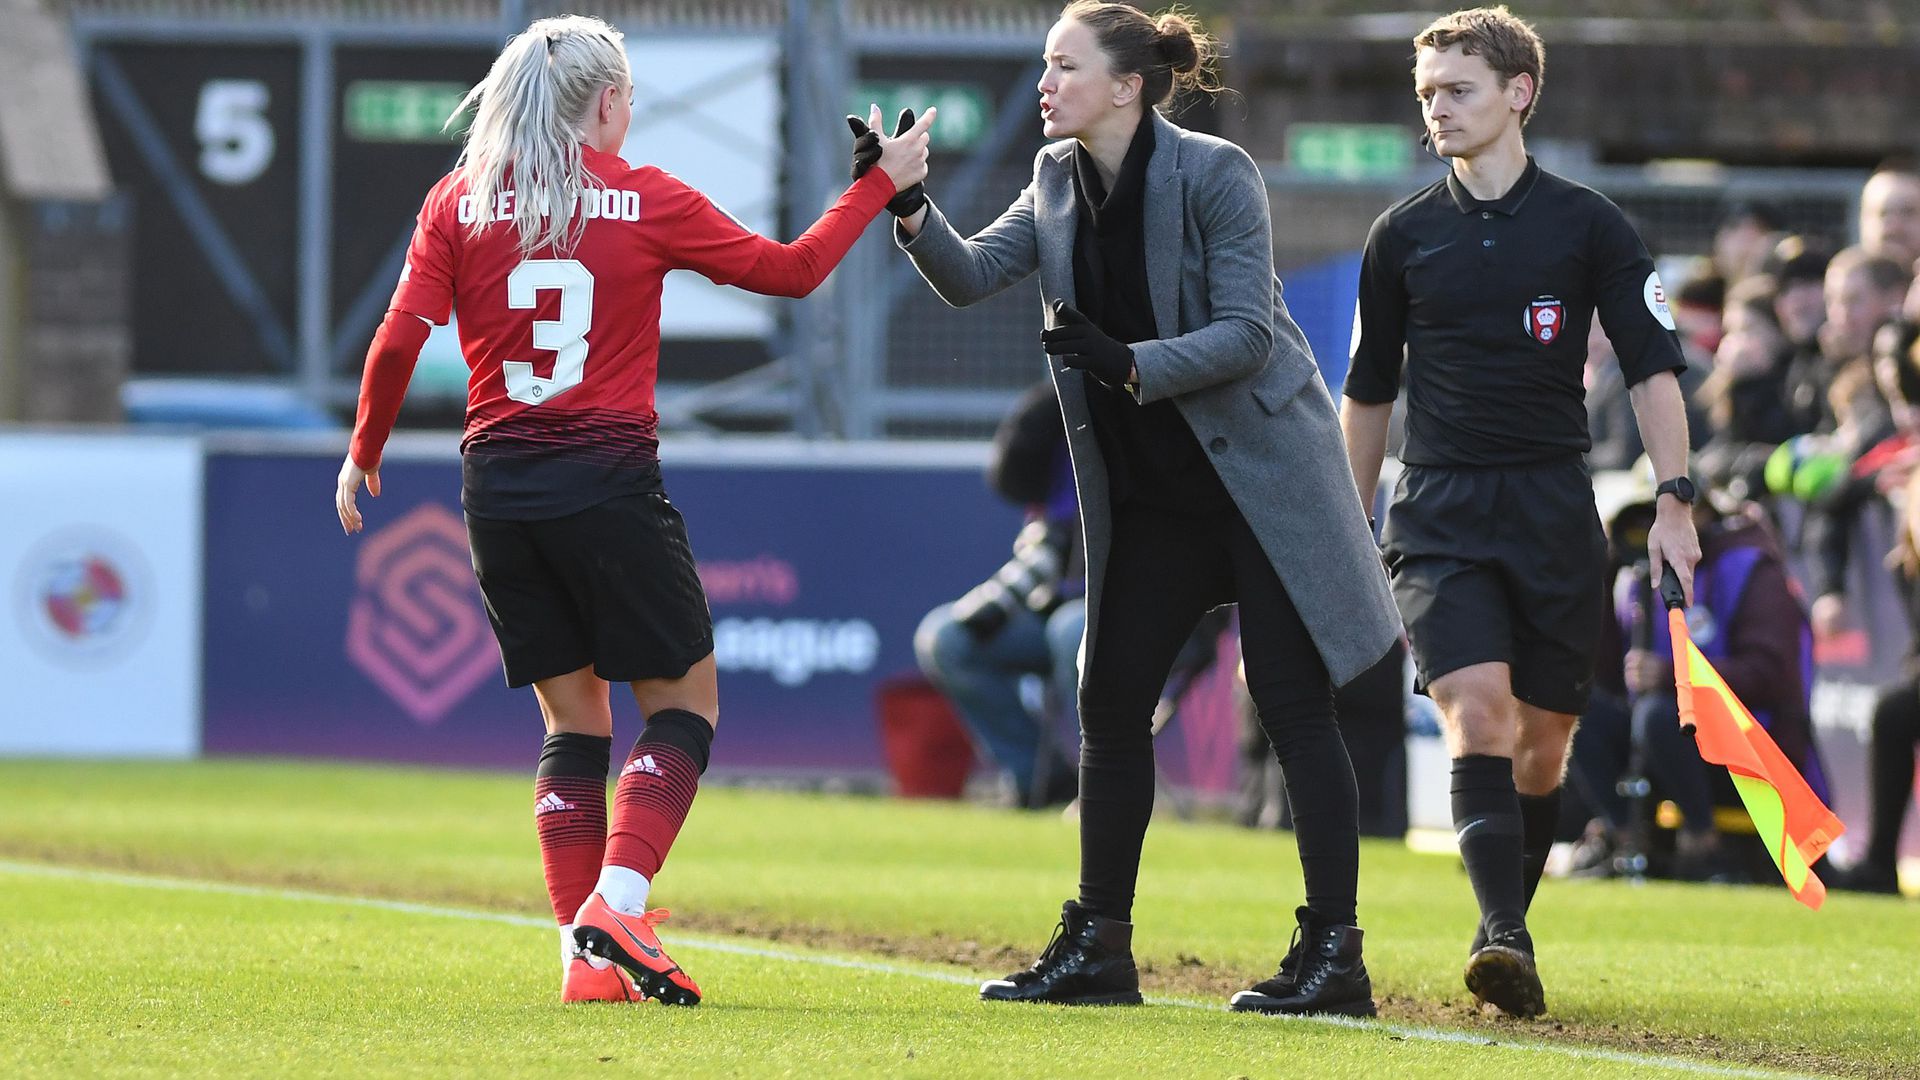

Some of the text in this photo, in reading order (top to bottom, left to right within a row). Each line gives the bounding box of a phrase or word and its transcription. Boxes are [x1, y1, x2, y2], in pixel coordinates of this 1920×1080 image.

[196, 80, 274, 184] 5
[457, 188, 641, 223] GRENOOD
[503, 259, 595, 405] 3
[711, 618, 879, 687] eague
